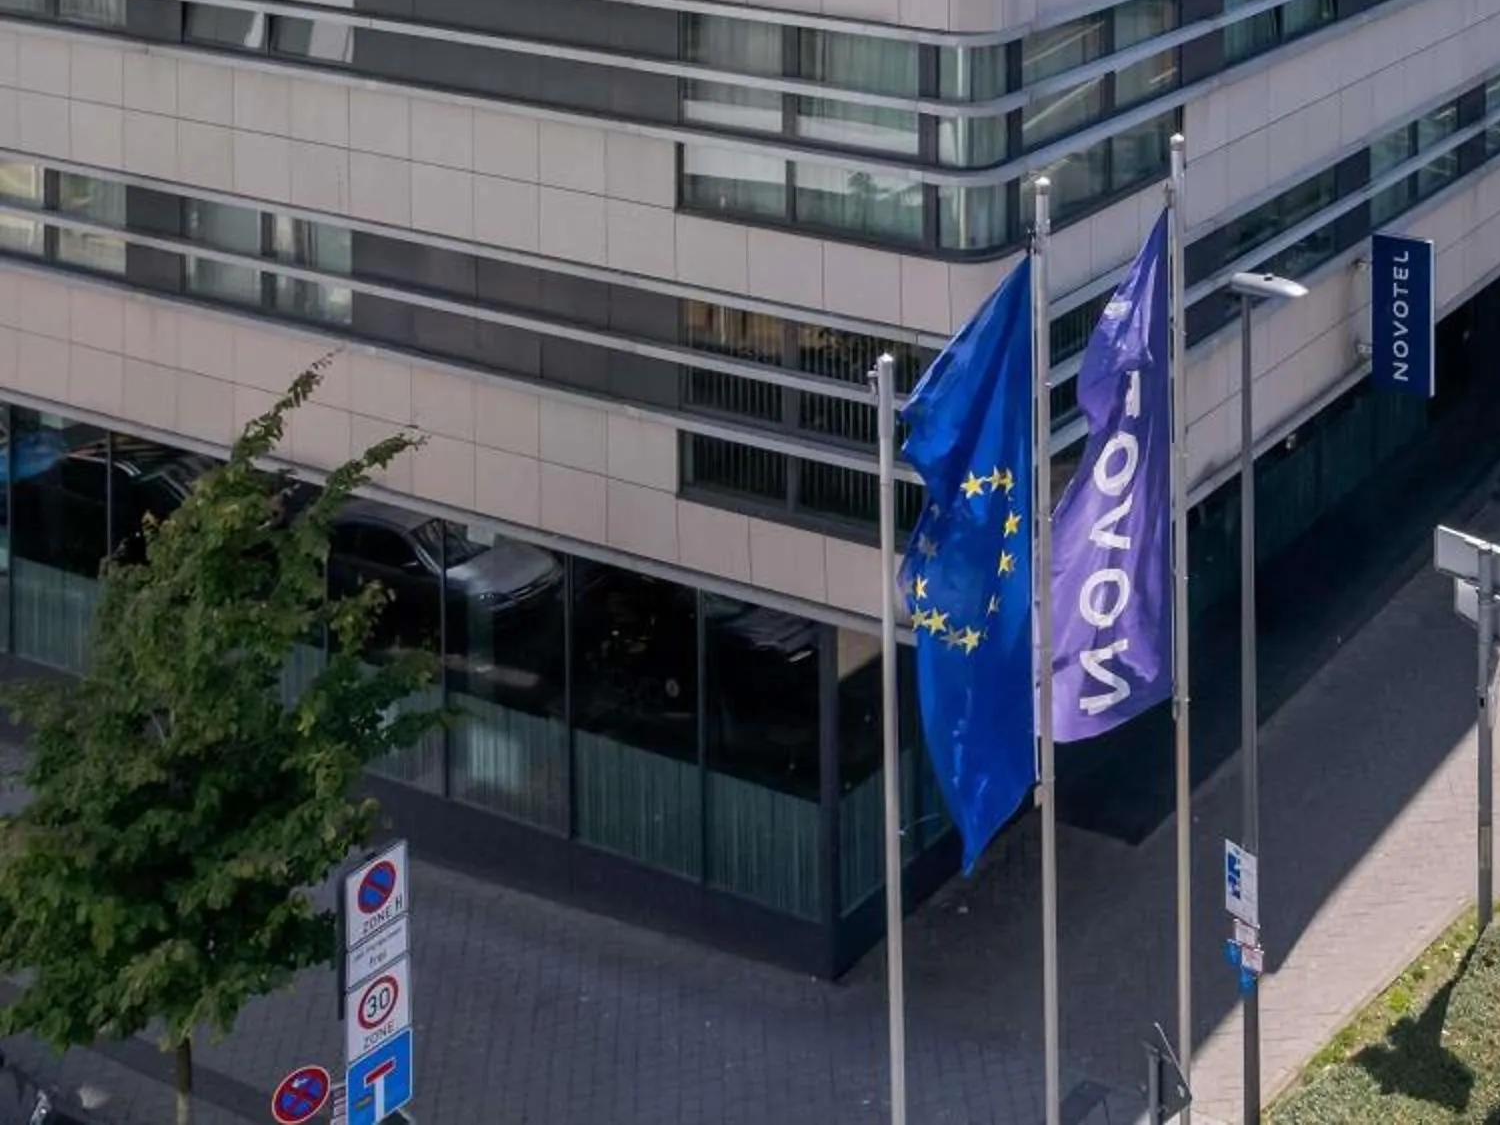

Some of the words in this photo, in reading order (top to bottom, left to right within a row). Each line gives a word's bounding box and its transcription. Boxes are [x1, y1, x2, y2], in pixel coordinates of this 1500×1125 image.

[1392, 250, 1410, 382] NOVOTEL
[363, 906, 393, 935] ZONE
[367, 986, 391, 1019] 30
[363, 1022, 394, 1051] ZONE
